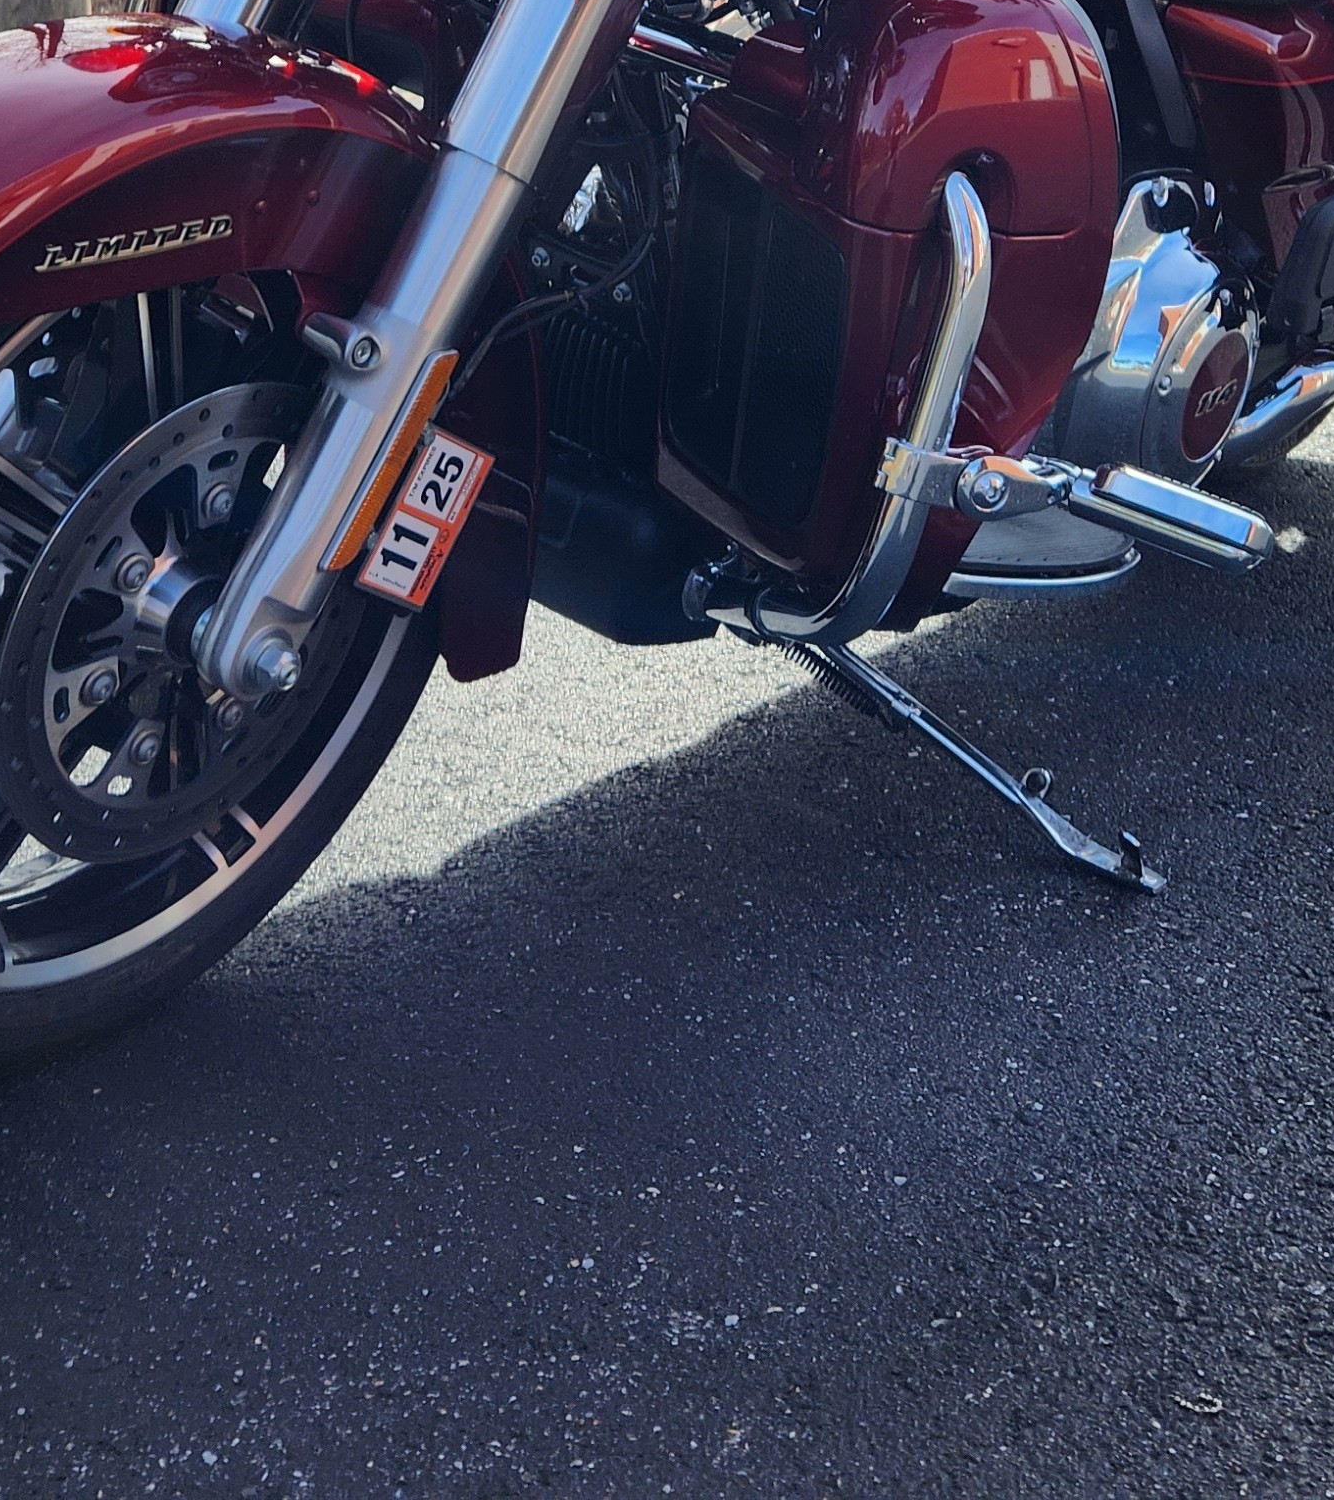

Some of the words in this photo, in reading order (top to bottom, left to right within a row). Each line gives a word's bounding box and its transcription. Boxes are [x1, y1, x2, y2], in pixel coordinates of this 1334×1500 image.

[43, 214, 233, 270] LIMITED
[420, 451, 464, 513] 25
[380, 522, 430, 572] 11
